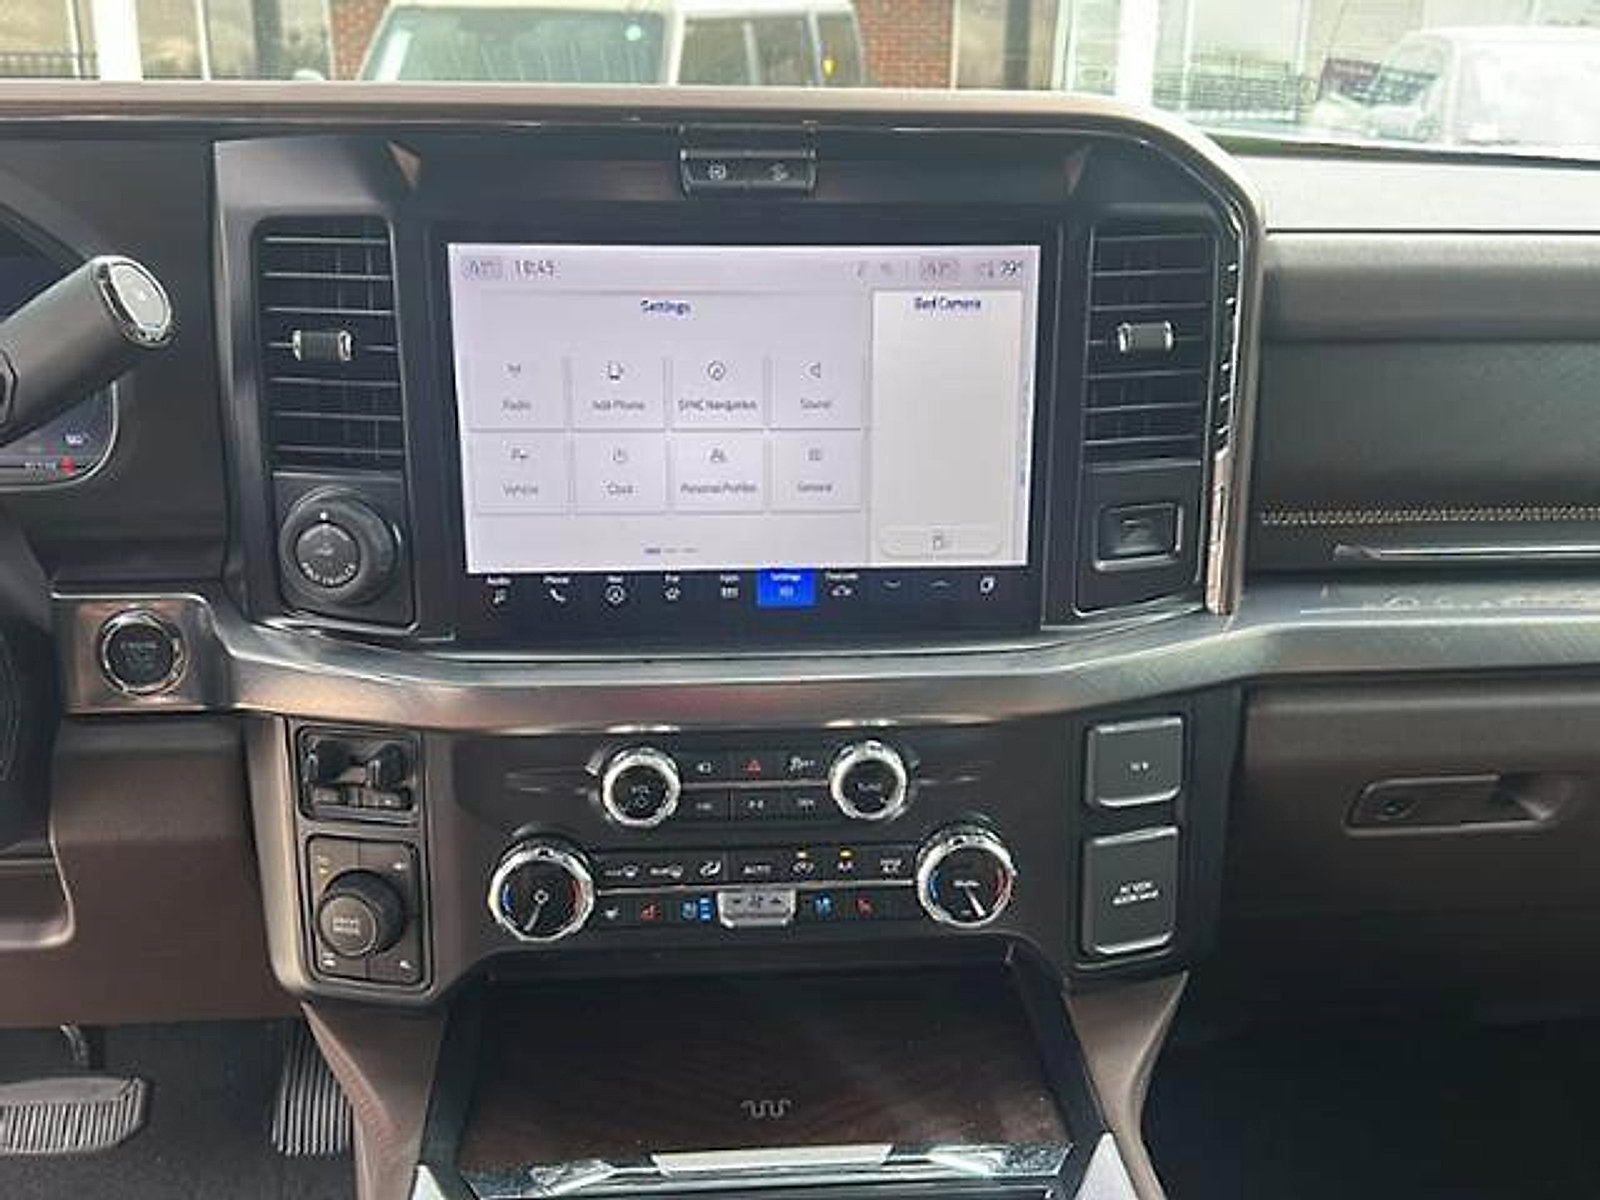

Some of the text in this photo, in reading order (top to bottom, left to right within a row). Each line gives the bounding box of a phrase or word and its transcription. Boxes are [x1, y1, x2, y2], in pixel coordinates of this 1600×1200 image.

[640, 299, 691, 316] Settings
[938, 297, 982, 310] Camera
[502, 399, 532, 411] Radio
[614, 400, 646, 412] Phone
[801, 399, 832, 410] Sound
[502, 483, 539, 496] Vehicle
[606, 483, 635, 496] Clock
[680, 483, 721, 495] Personal
[798, 482, 833, 493] General
[486, 575, 512, 586] Audio
[769, 571, 802, 583] Settings
